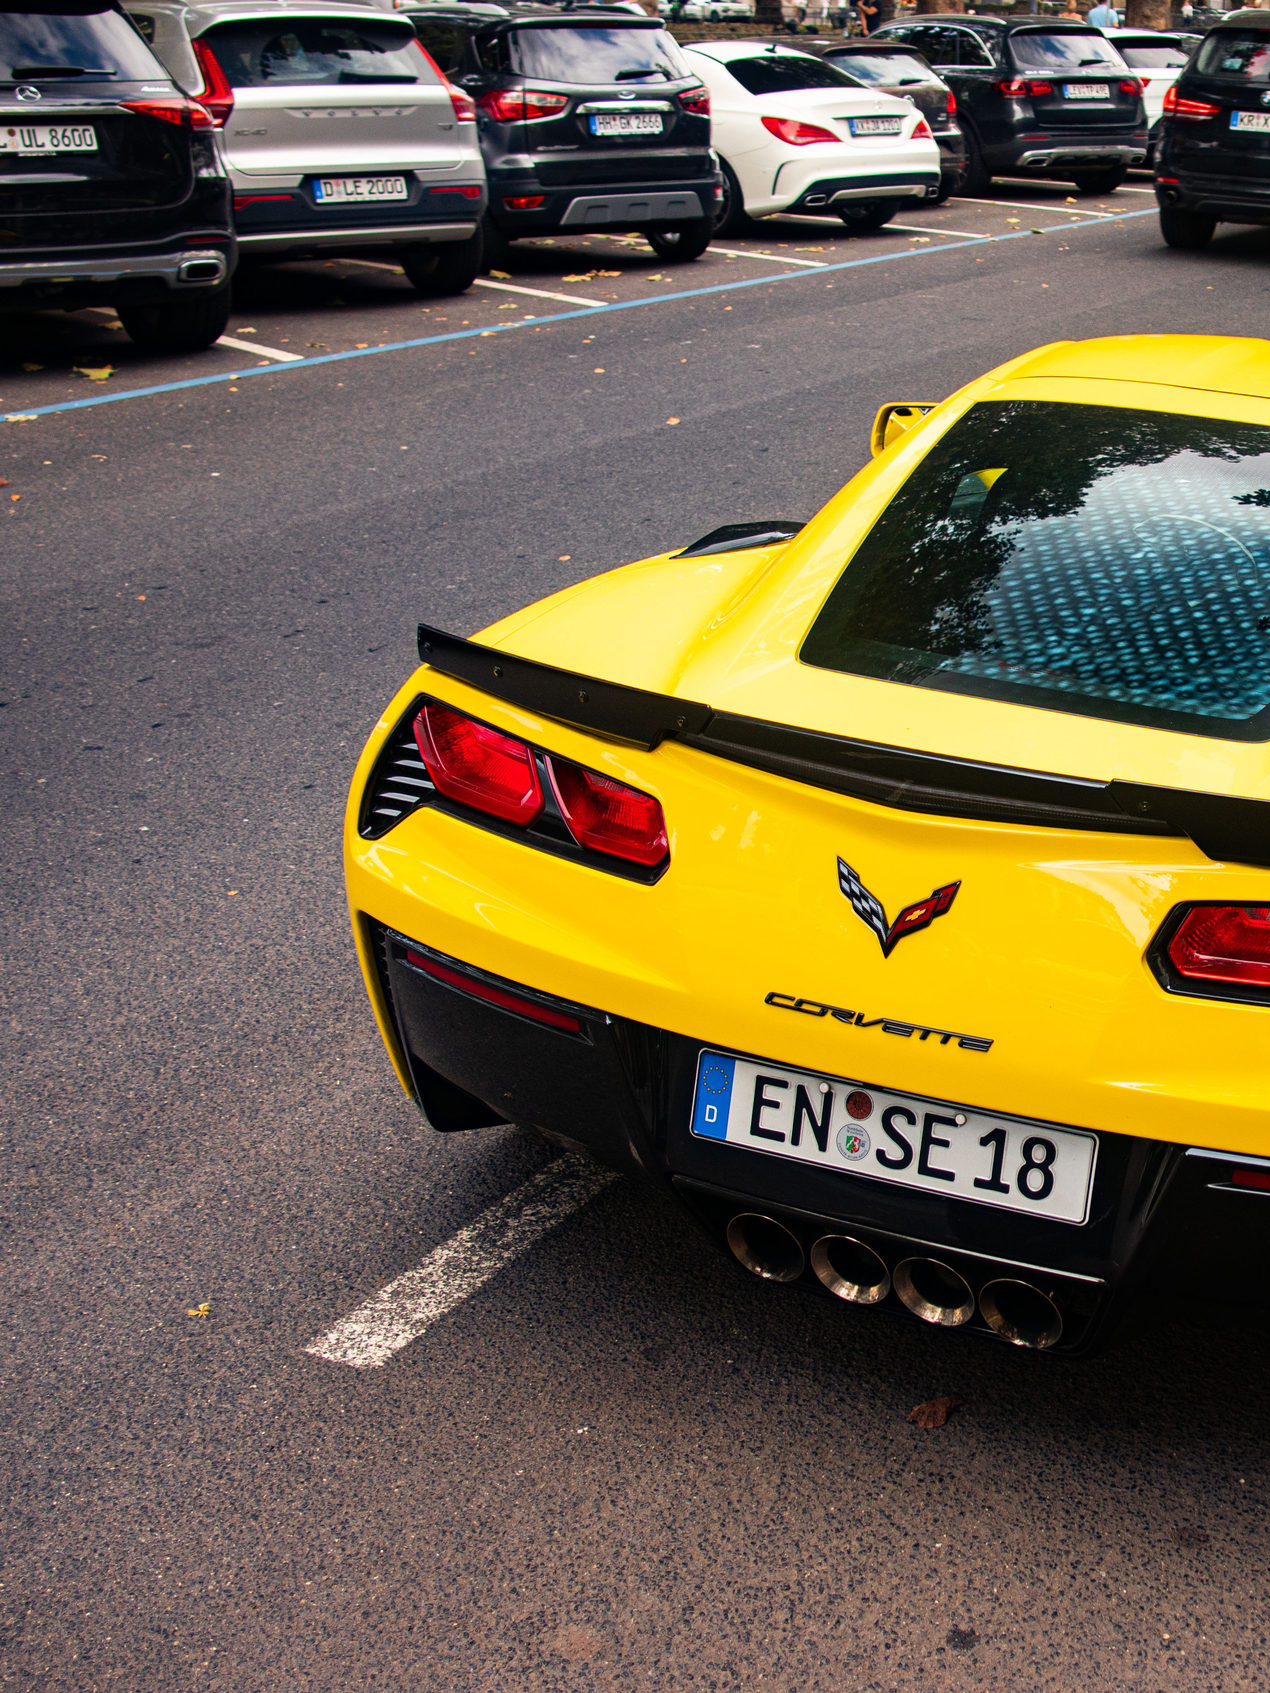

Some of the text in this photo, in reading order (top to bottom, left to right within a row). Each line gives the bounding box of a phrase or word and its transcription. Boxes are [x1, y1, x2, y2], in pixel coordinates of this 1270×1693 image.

[302, 109, 403, 118] VOLVO
[598, 114, 661, 131] HH GK 2666
[1239, 114, 1255, 127] KR
[19, 128, 94, 148] UL 8600
[323, 178, 404, 197] D LE 2000
[763, 991, 995, 1053] CORVETTE
[704, 1103, 718, 1124] D
[749, 1074, 835, 1153] EN
[972, 1127, 1058, 1201] 18
